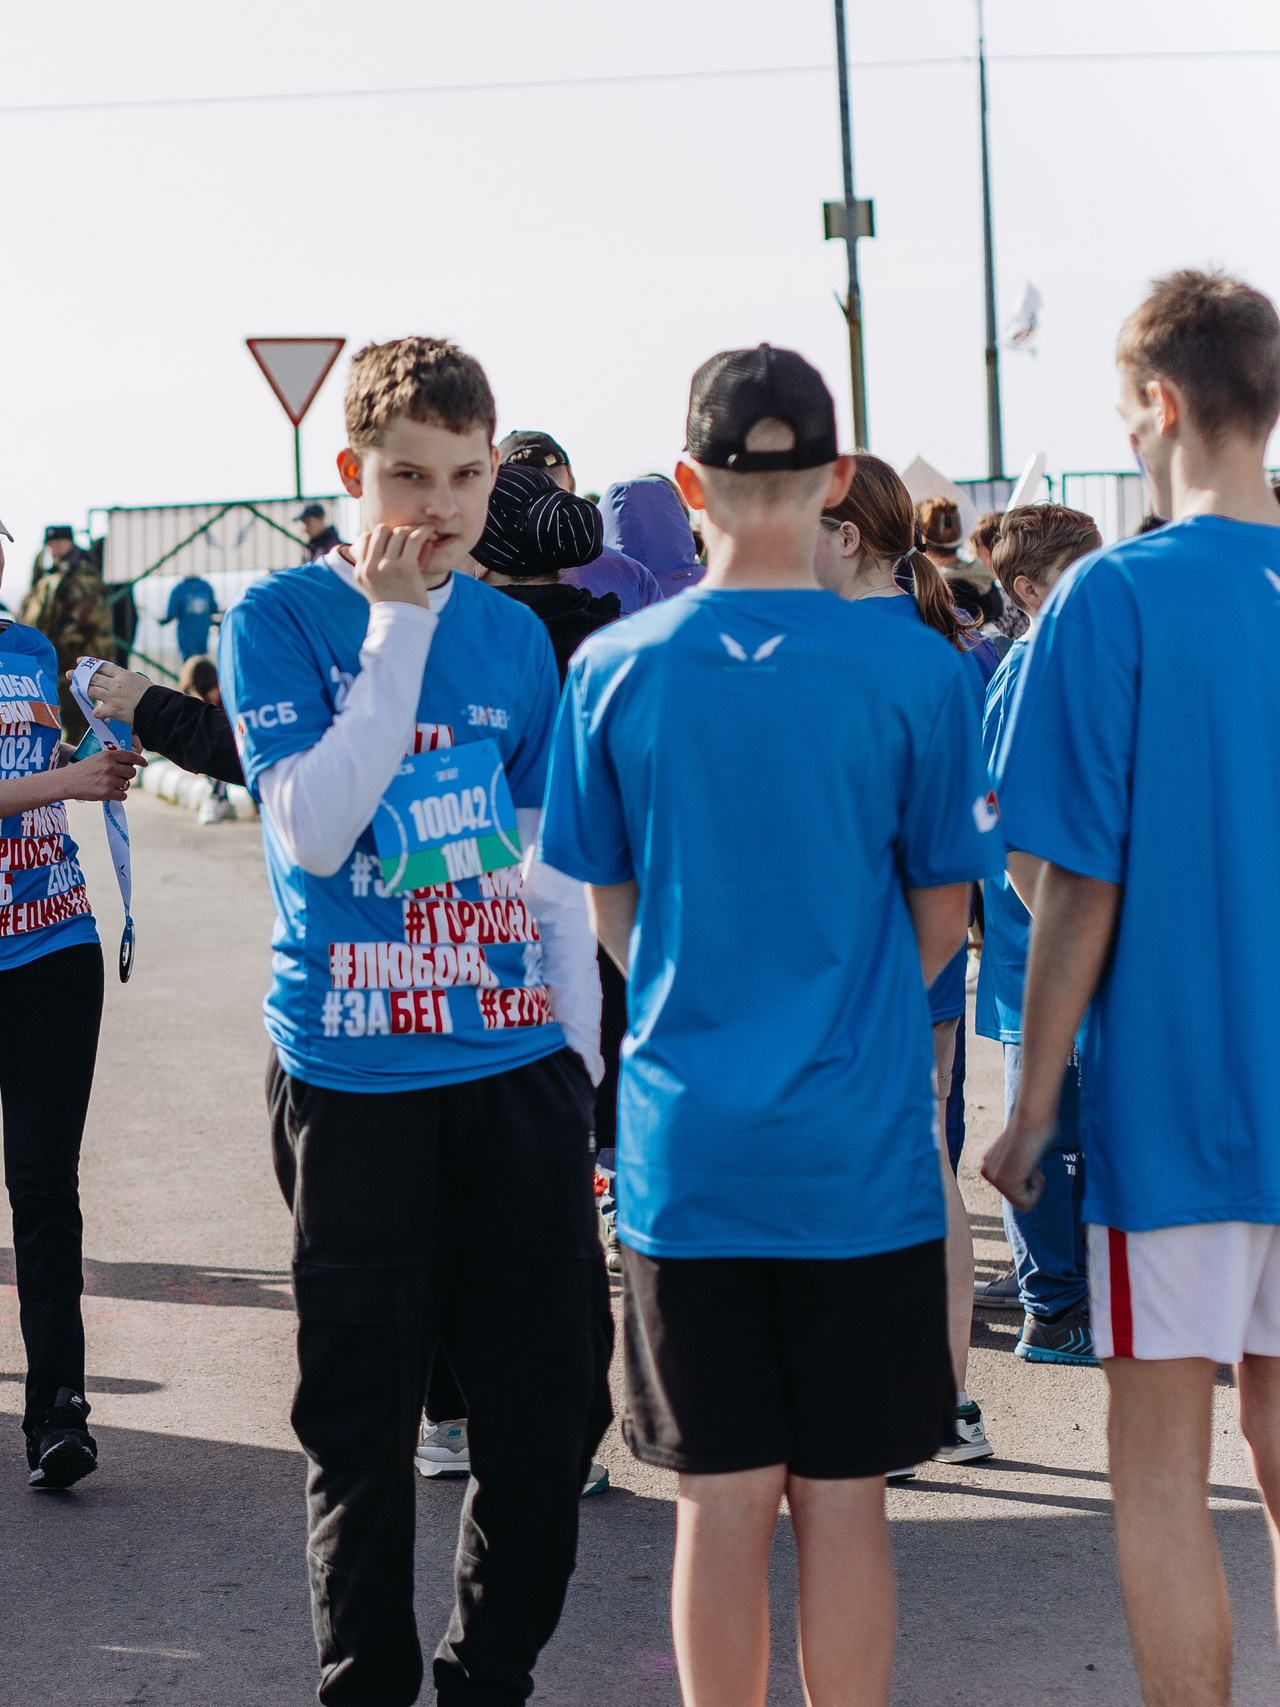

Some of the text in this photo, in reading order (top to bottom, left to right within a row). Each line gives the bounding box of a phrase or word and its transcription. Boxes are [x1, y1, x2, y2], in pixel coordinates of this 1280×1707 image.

[409, 786, 492, 842] 10042
[329, 942, 500, 990] #ЛЮБОВЬ
[321, 988, 454, 1038] #ЗАБЕГ
